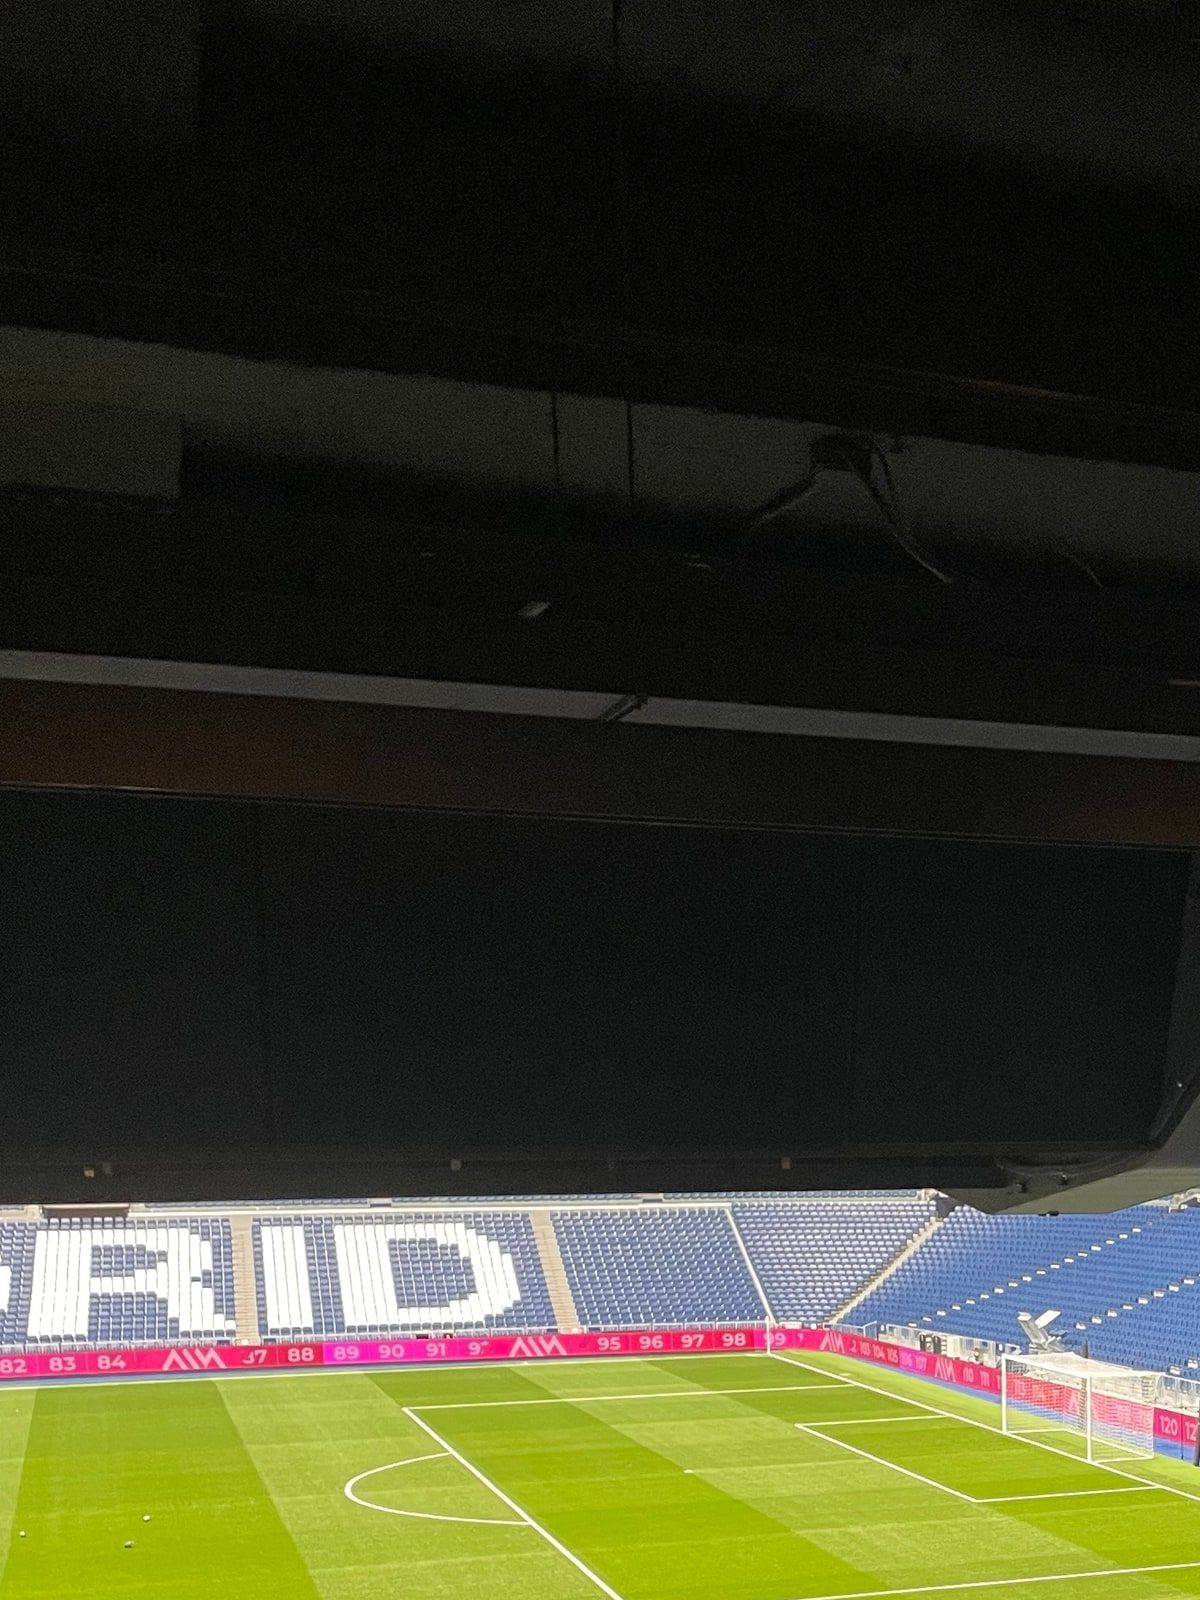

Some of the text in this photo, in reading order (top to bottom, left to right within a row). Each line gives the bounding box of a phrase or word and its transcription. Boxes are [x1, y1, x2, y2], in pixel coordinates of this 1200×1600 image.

[0, 1222, 519, 1336] RID
[0, 1358, 27, 1374] 82
[49, 1356, 76, 1372] 83
[97, 1354, 126, 1370] 84
[287, 1347, 314, 1363] 88
[333, 1346, 360, 1360] 89
[378, 1343, 405, 1358] 90
[425, 1342, 447, 1357] 91
[597, 1336, 621, 1350] 95
[639, 1335, 663, 1349] 96
[681, 1334, 705, 1348] 97
[722, 1333, 746, 1347] 98
[1159, 1415, 1179, 1436] 120
[1184, 1421, 1200, 1441] 12
